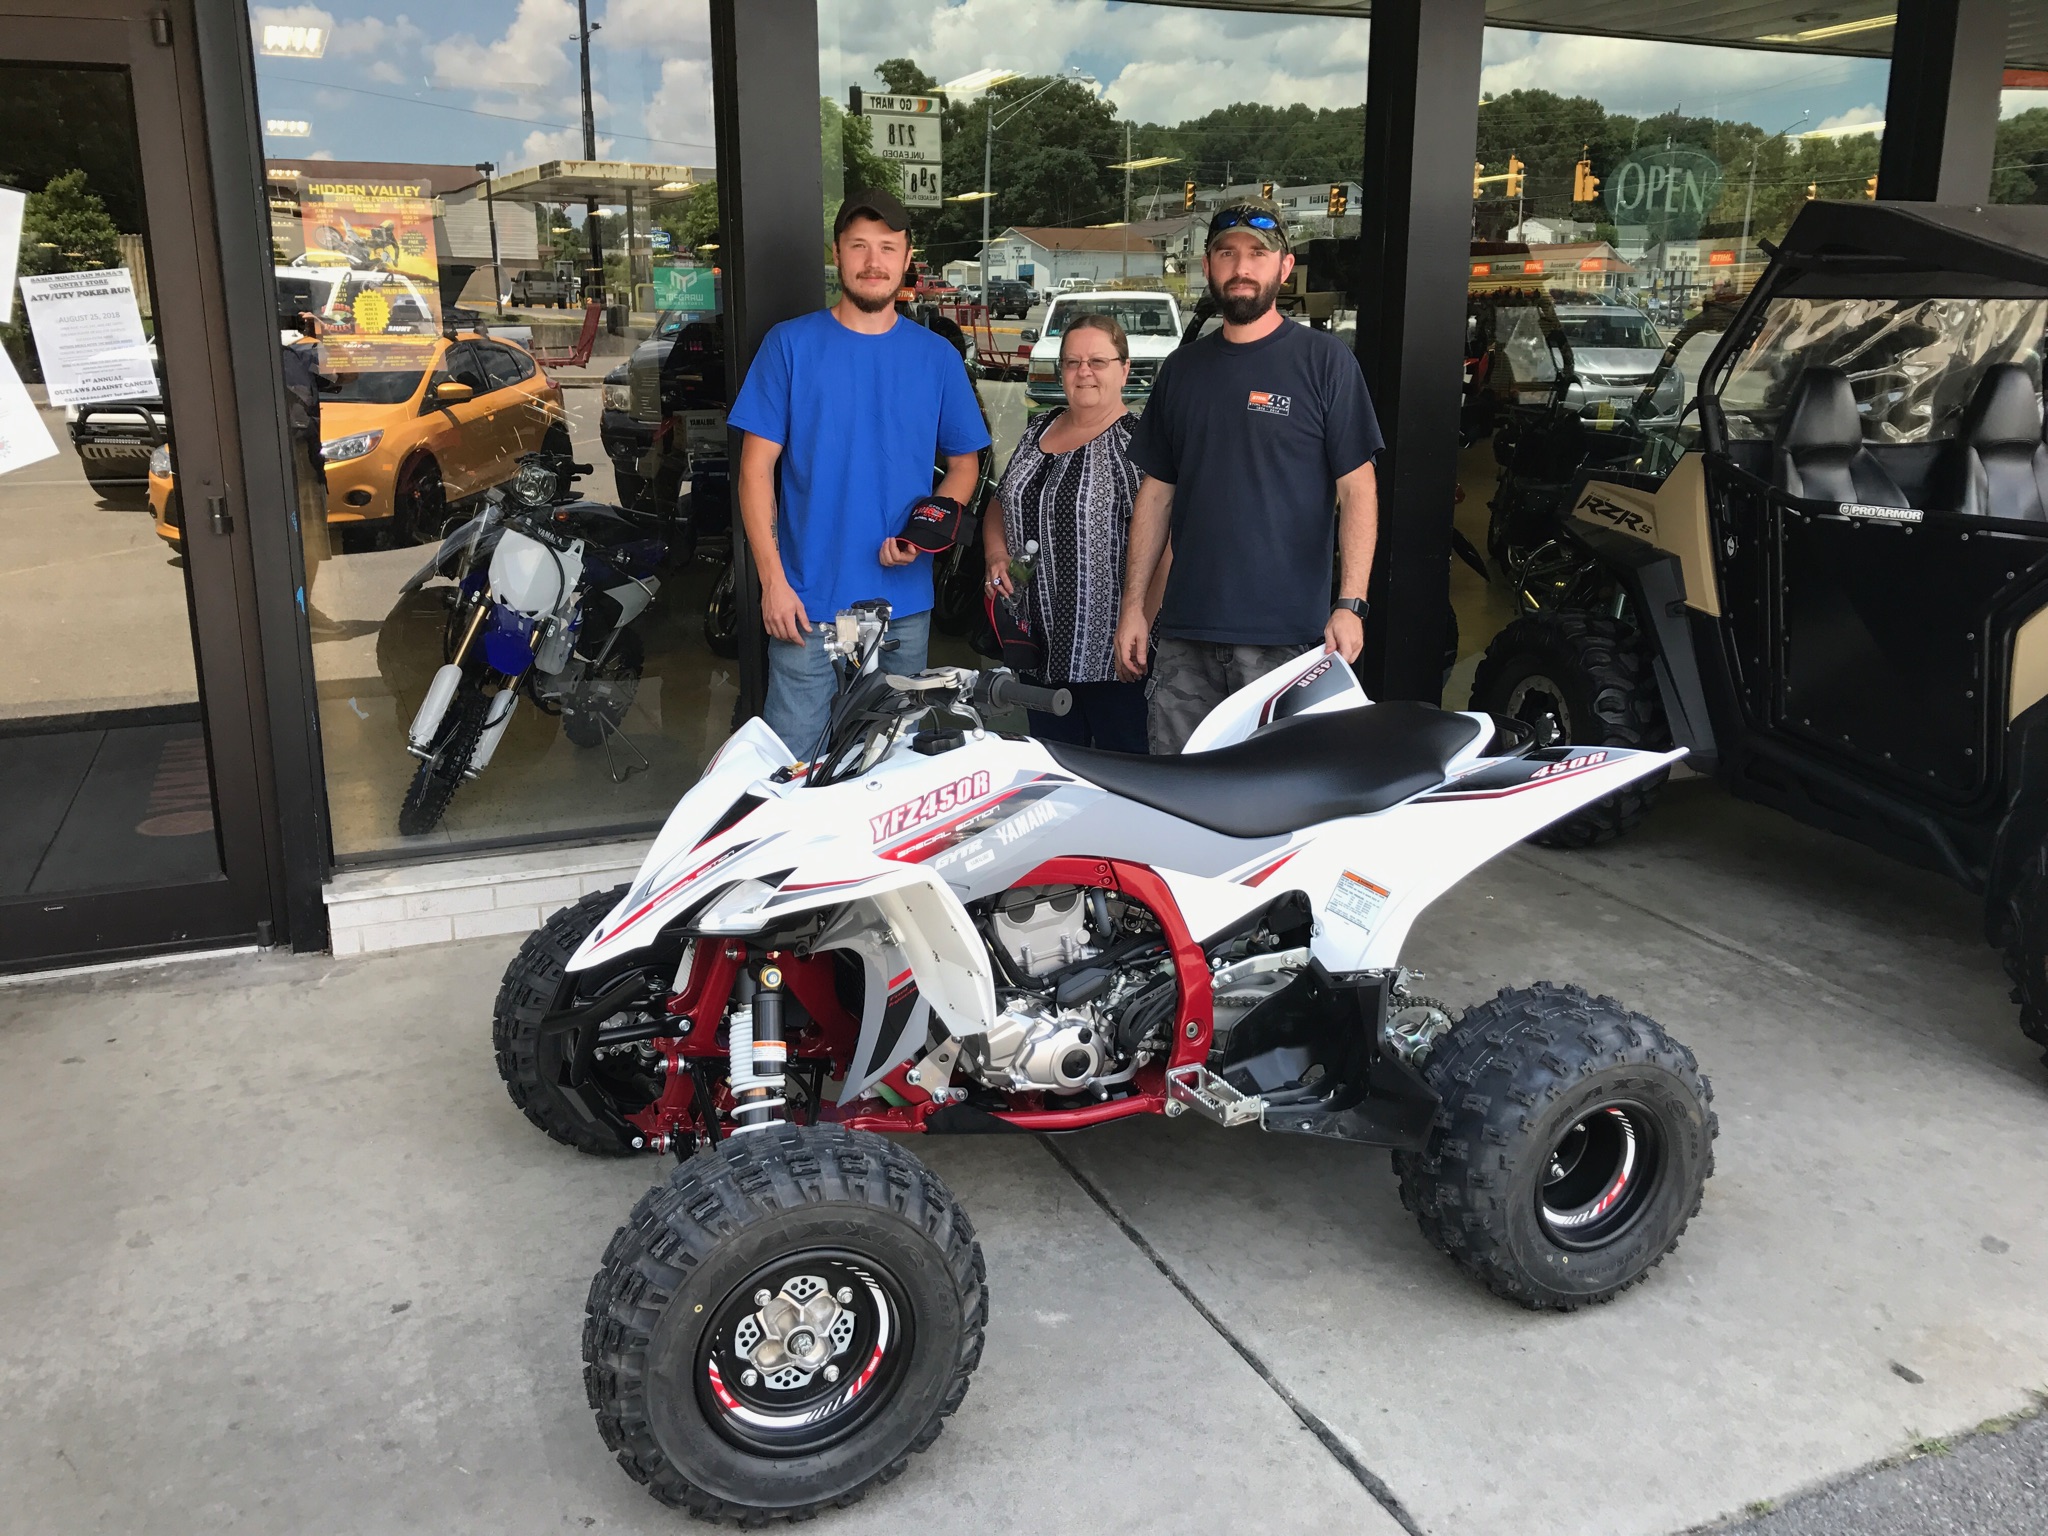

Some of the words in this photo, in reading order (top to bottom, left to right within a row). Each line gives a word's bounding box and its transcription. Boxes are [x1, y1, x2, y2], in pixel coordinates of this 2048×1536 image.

[308, 184, 366, 196] HIDDEN
[368, 185, 421, 197] VALLEY
[1617, 162, 1707, 214] OPEN
[1711, 253, 1733, 262] STIHL
[1473, 265, 1489, 273] STIHL
[1582, 260, 1599, 268] STIHL
[54, 273, 94, 281] MOUNTAIN
[49, 281, 84, 290] COUNTRY
[30, 291, 75, 302] ATV/UTV
[77, 288, 109, 298] POKER
[110, 286, 131, 294] RUN
[58, 315, 88, 323] AUGUST
[90, 313, 101, 321] 25,
[102, 312, 121, 320] 2018
[92, 375, 124, 383] ANNUAL
[54, 386, 90, 396] OUTLAWS
[91, 383, 123, 392] AGAINST
[124, 380, 153, 388] CANCER
[1577, 495, 1644, 532] RZR
[1639, 524, 1653, 534] S
[1851, 505, 1876, 517] PRO
[1876, 506, 1922, 520] ARMOR
[1297, 660, 1332, 688] 450R
[1529, 751, 1609, 780] 450R
[869, 769, 990, 844] YFZ450R
[996, 800, 1058, 846] YAMAHA
[897, 831, 951, 859] SPECIAL
[955, 804, 1000, 832] EDITION
[935, 838, 985, 870] GYTR
[1550, 1077, 1688, 1131] MAXXIS
